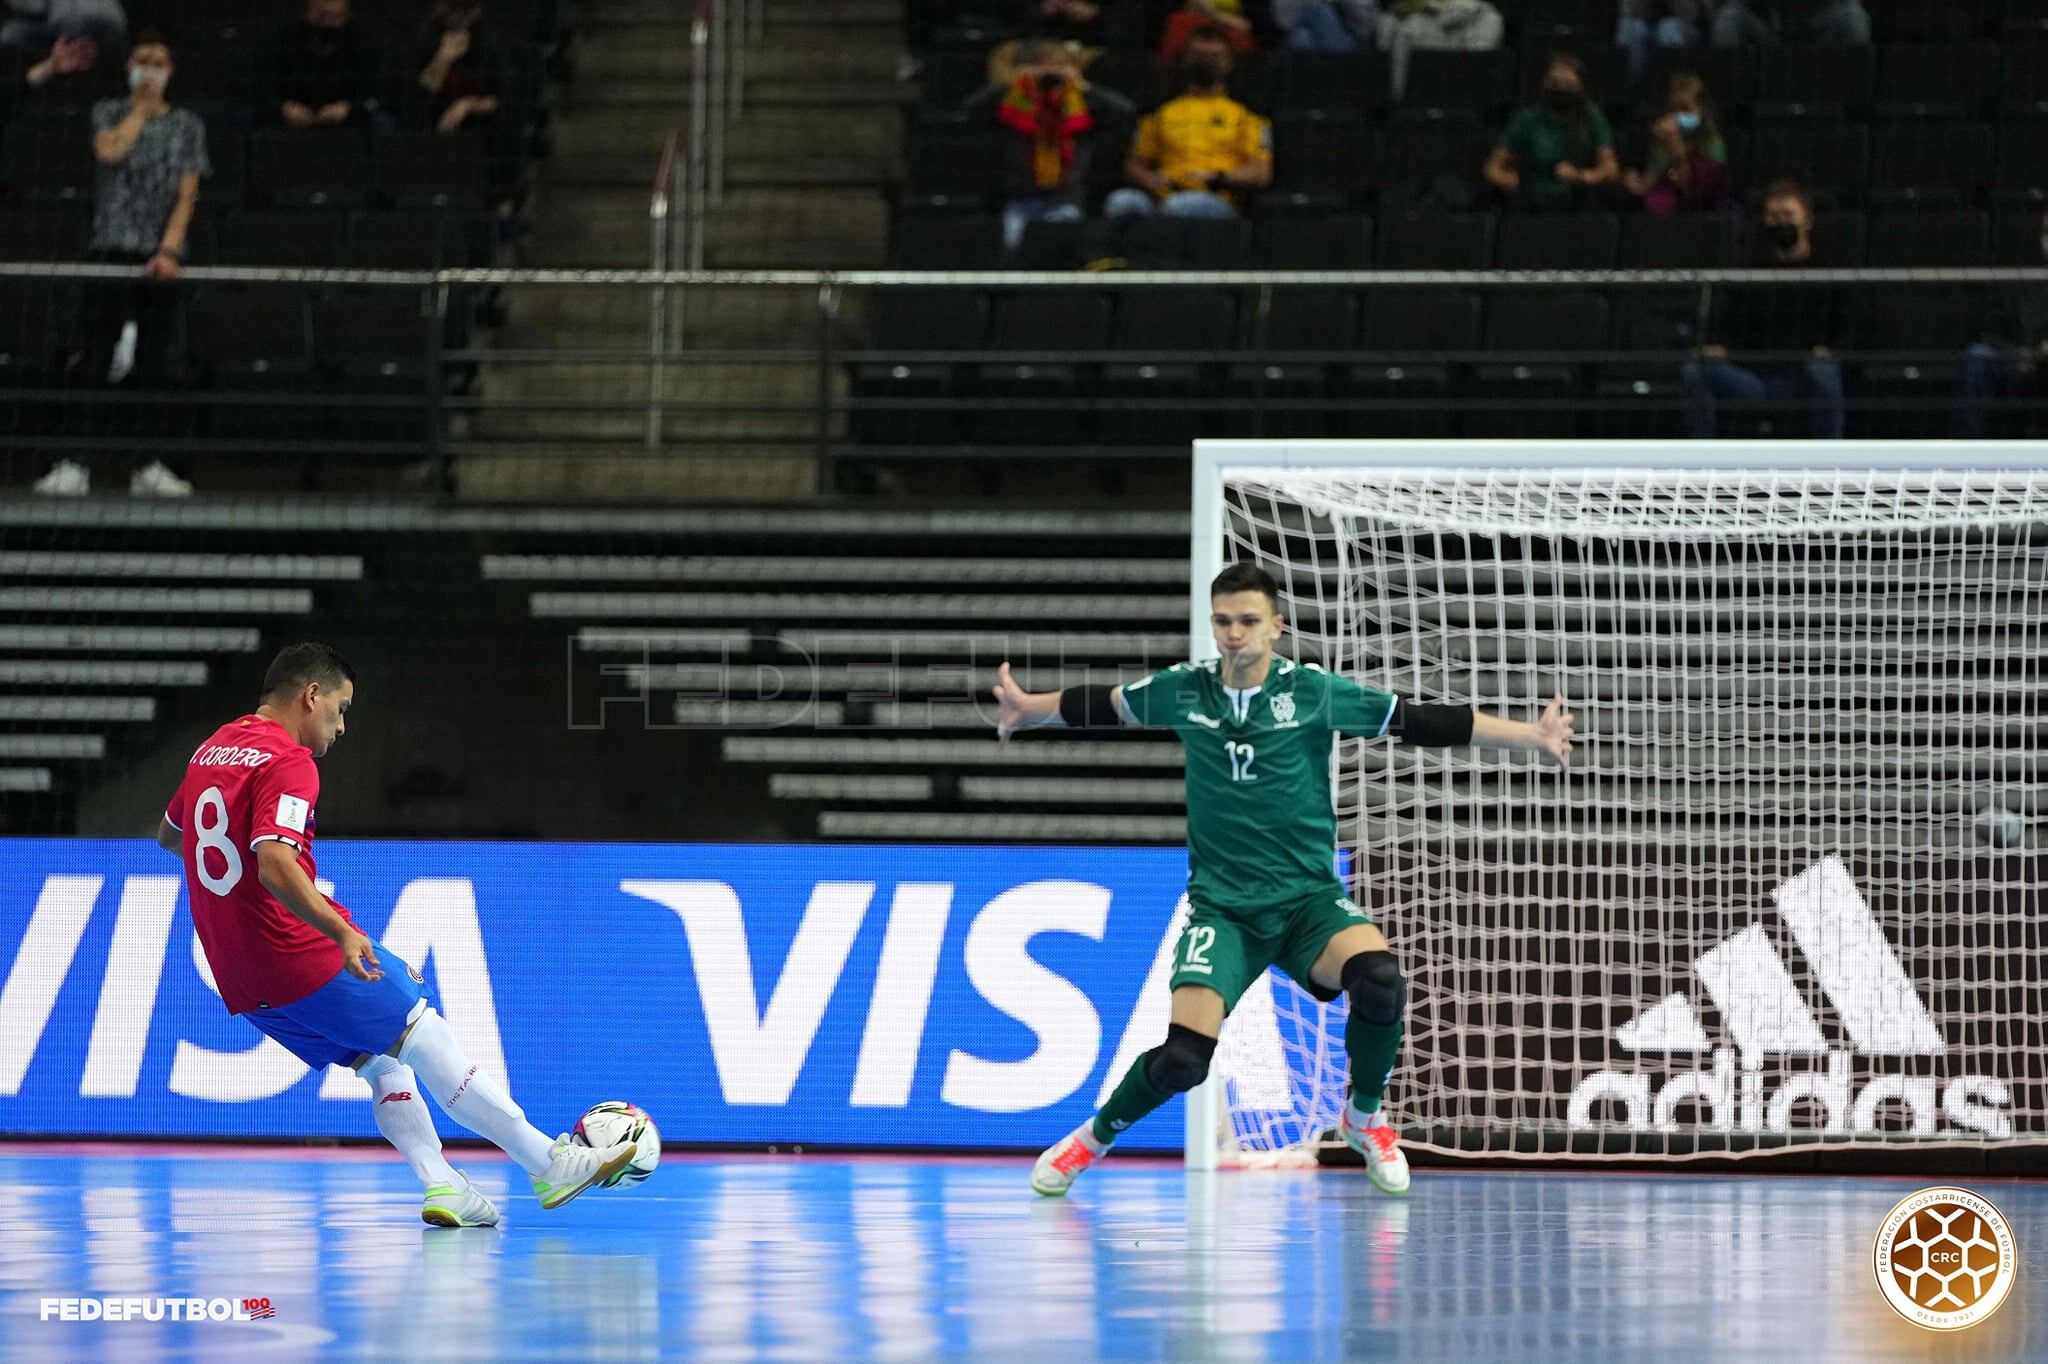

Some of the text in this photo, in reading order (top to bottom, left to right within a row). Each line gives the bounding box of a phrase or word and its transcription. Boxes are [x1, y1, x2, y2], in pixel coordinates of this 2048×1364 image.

[199, 745, 273, 767] CORDERO
[1224, 740, 1258, 781] 12
[194, 786, 243, 897] 8
[1186, 926, 1216, 964] 12
[1567, 1047, 2012, 1137] adidas
